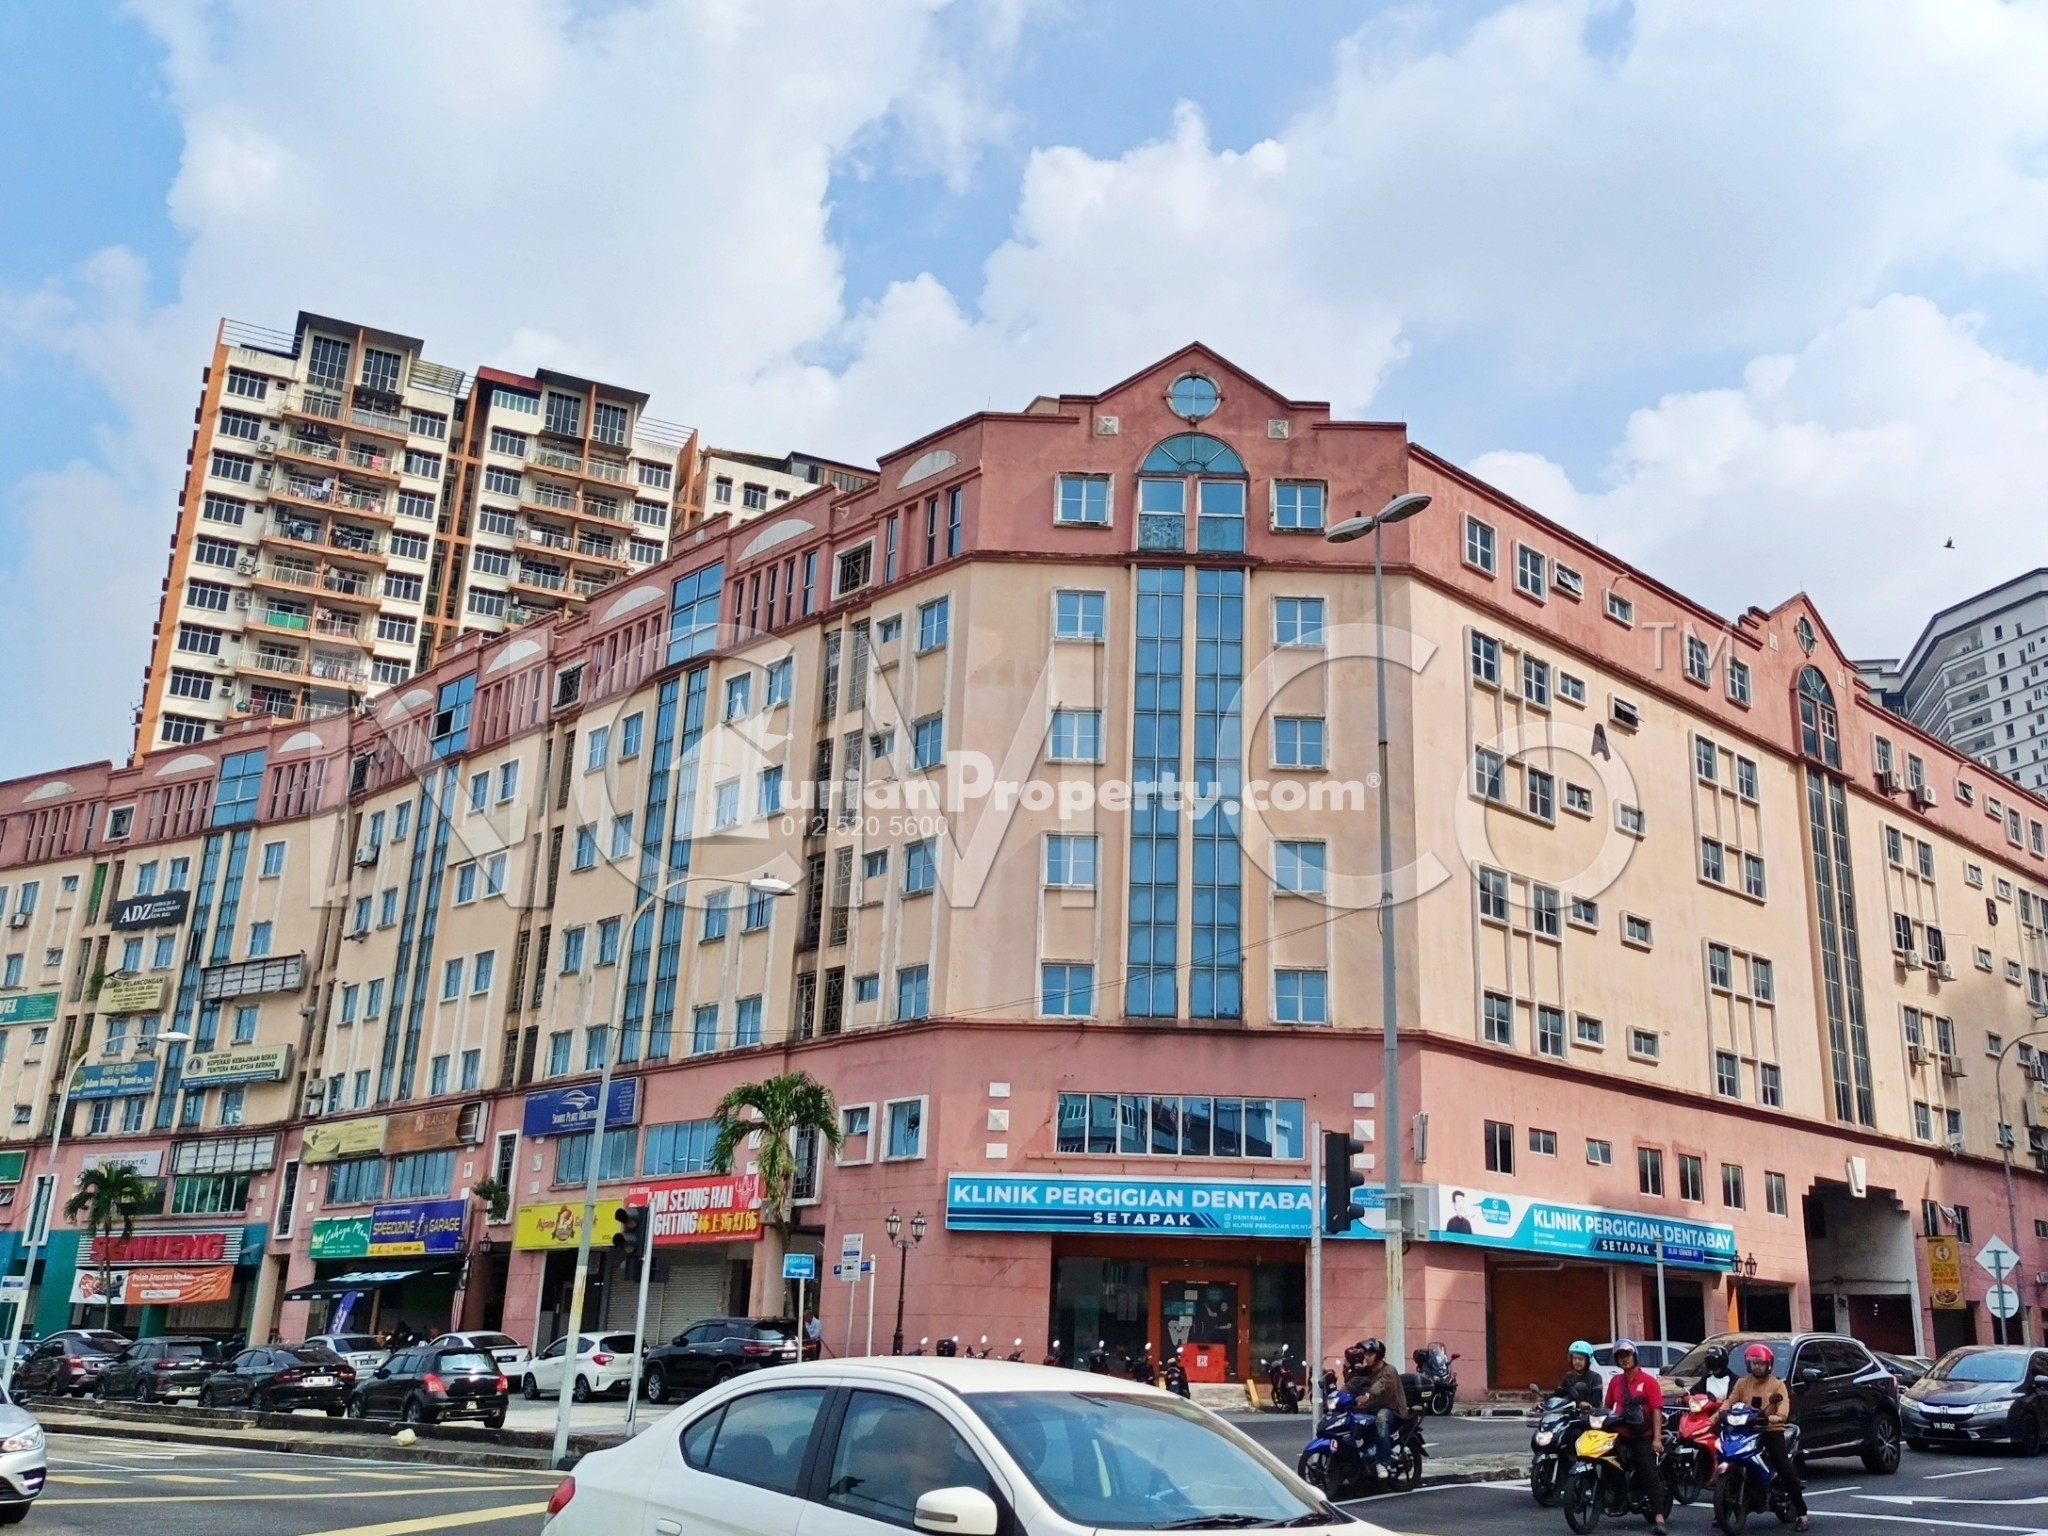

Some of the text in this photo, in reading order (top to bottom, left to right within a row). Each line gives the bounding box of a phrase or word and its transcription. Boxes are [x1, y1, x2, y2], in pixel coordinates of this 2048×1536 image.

[120, 904, 153, 924] ADZ
[669, 1186, 710, 1210] SEONG
[710, 1184, 734, 1208] HAI
[954, 1185, 1038, 1203] KLINIK
[1045, 1187, 1184, 1207] PERGIGIAN
[372, 1220, 415, 1236] SPEEDZONE
[429, 1217, 460, 1232] GARAGE
[1093, 1212, 1191, 1226] SETAPAK
[1533, 1208, 1731, 1250] KLINIK PERGIGIAN DENTABAY
[1602, 1239, 1650, 1255] SETAPAK
